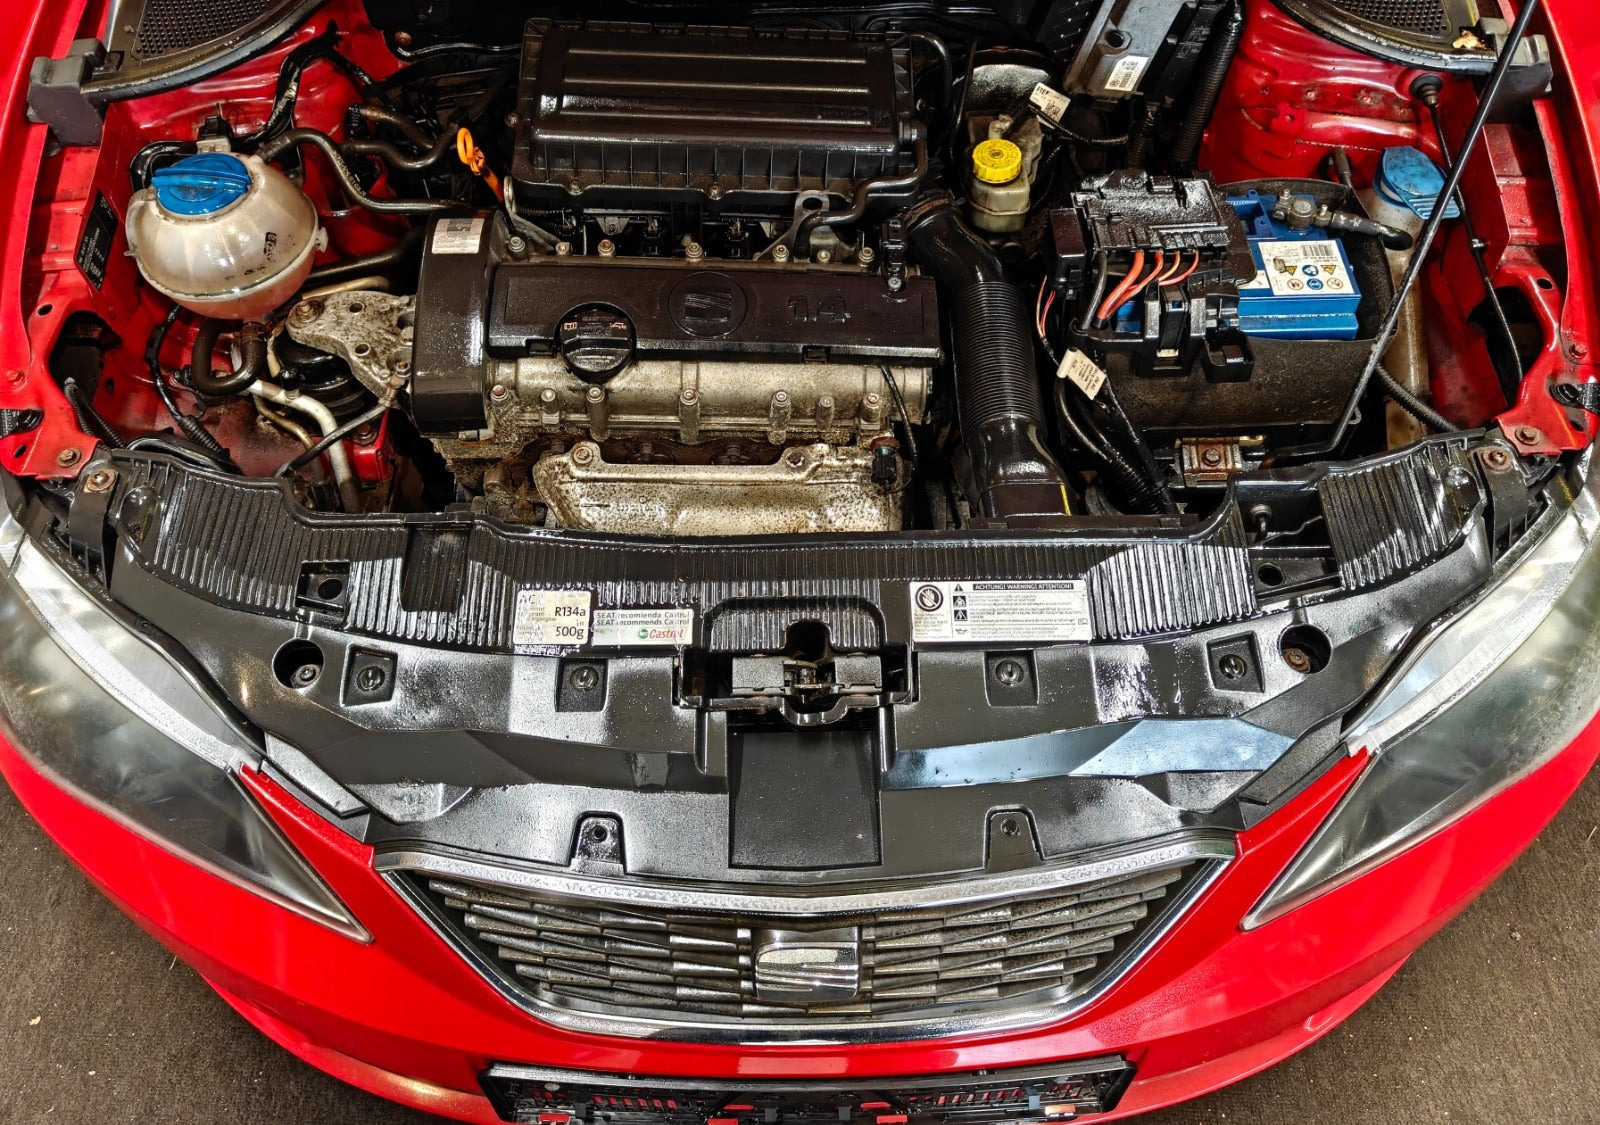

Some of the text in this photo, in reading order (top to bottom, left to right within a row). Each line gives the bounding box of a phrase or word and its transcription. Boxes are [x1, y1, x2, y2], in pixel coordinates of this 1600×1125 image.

[788, 296, 852, 322] 1.4
[555, 606, 586, 617] R134a
[555, 626, 584, 640] 500g
